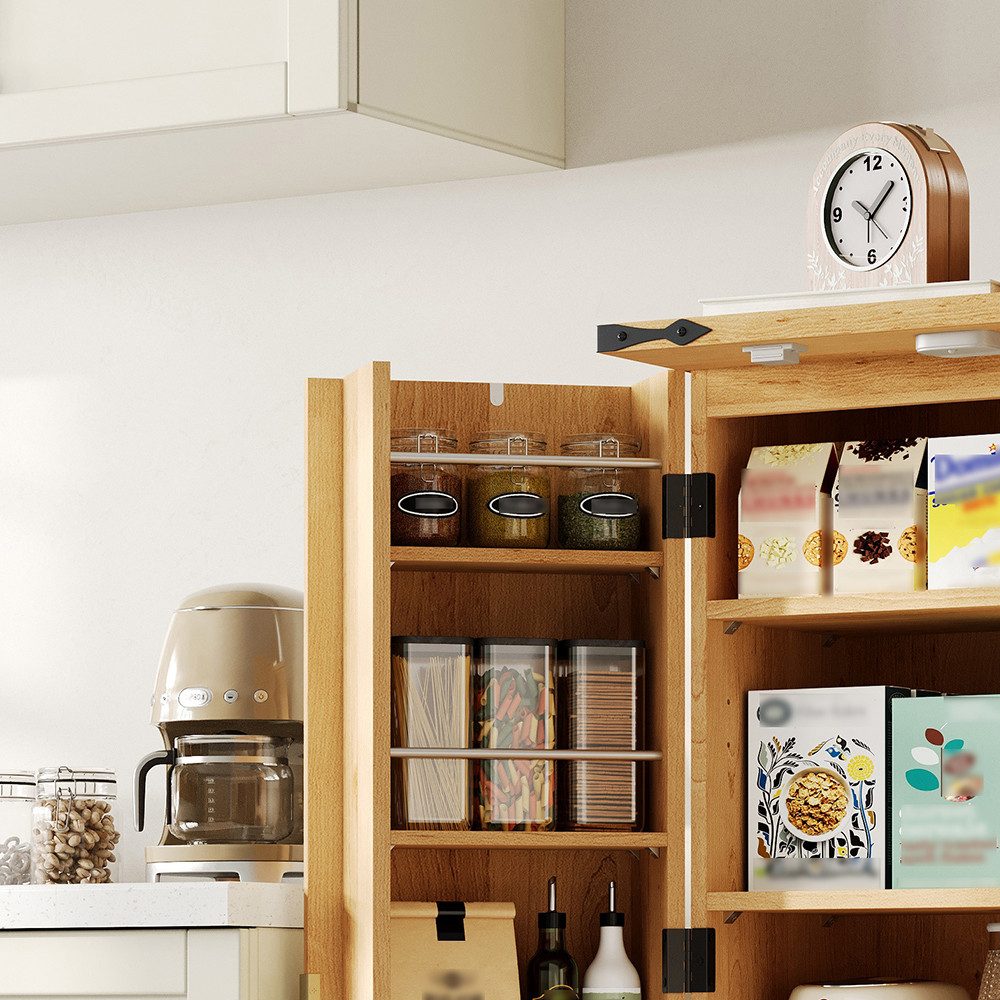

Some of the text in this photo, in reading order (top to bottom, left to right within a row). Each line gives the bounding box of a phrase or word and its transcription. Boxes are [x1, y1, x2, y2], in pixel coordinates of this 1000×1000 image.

[863, 155, 882, 171] 12
[833, 207, 842, 222] 9
[868, 249, 876, 264] 6
